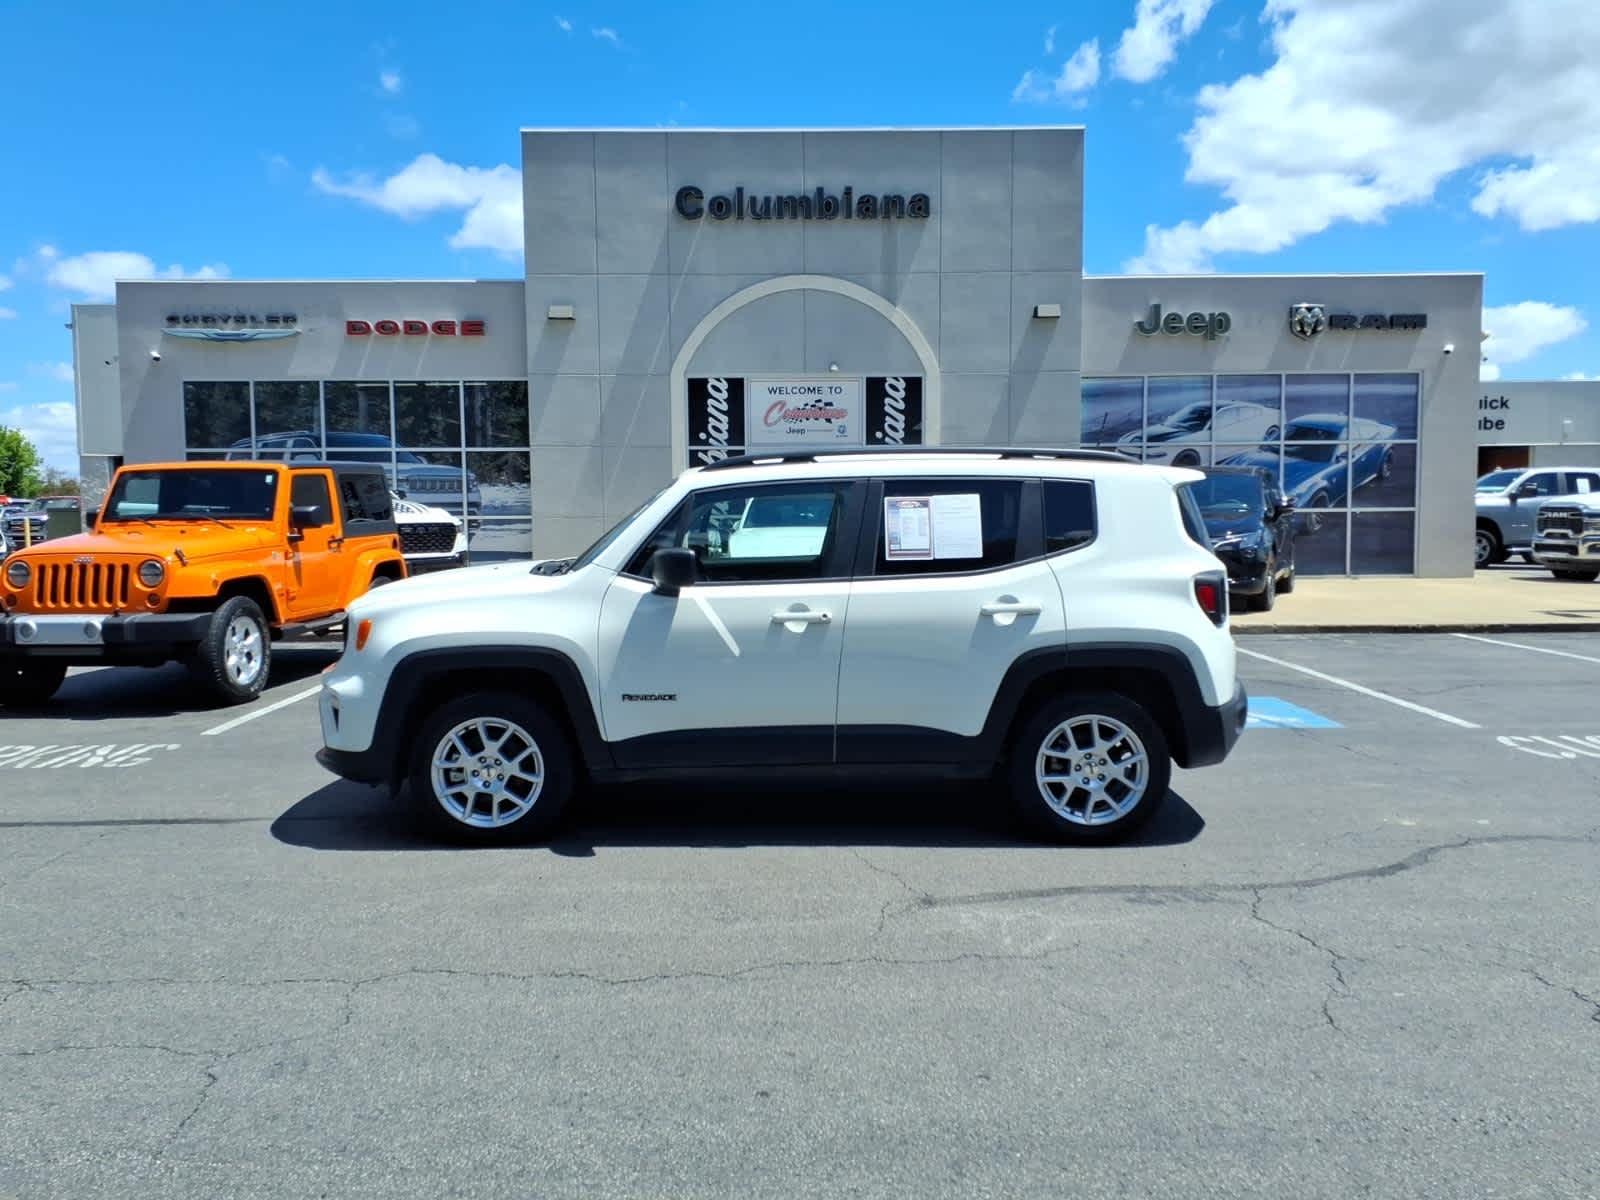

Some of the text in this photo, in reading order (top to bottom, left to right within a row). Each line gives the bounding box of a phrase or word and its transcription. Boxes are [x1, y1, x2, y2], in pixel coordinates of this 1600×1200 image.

[675, 185, 931, 220] Columbiana
[166, 313, 297, 324] CHRYSLER
[1136, 303, 1231, 340] Jeep
[1329, 314, 1427, 329] RAM
[346, 320, 485, 336] DODGE
[768, 386, 842, 395] WELCOME TO
[786, 427, 806, 435] Jeep
